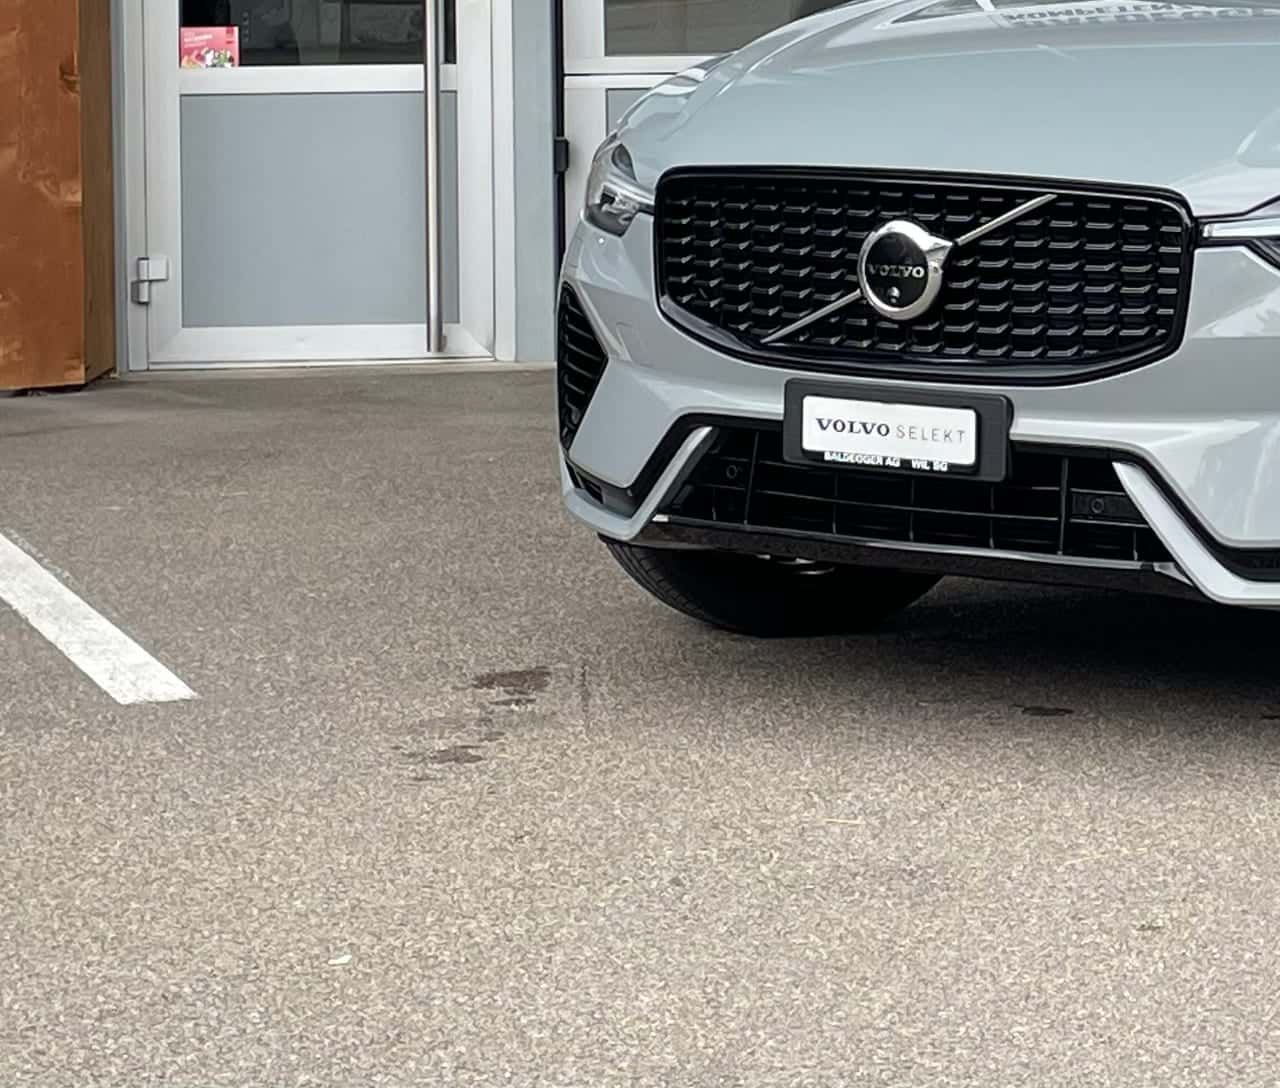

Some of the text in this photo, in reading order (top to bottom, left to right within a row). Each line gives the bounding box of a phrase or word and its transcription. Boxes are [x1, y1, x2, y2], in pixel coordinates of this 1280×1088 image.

[867, 263, 925, 279] VOLVO
[816, 417, 966, 444] VOLVO SELEKT
